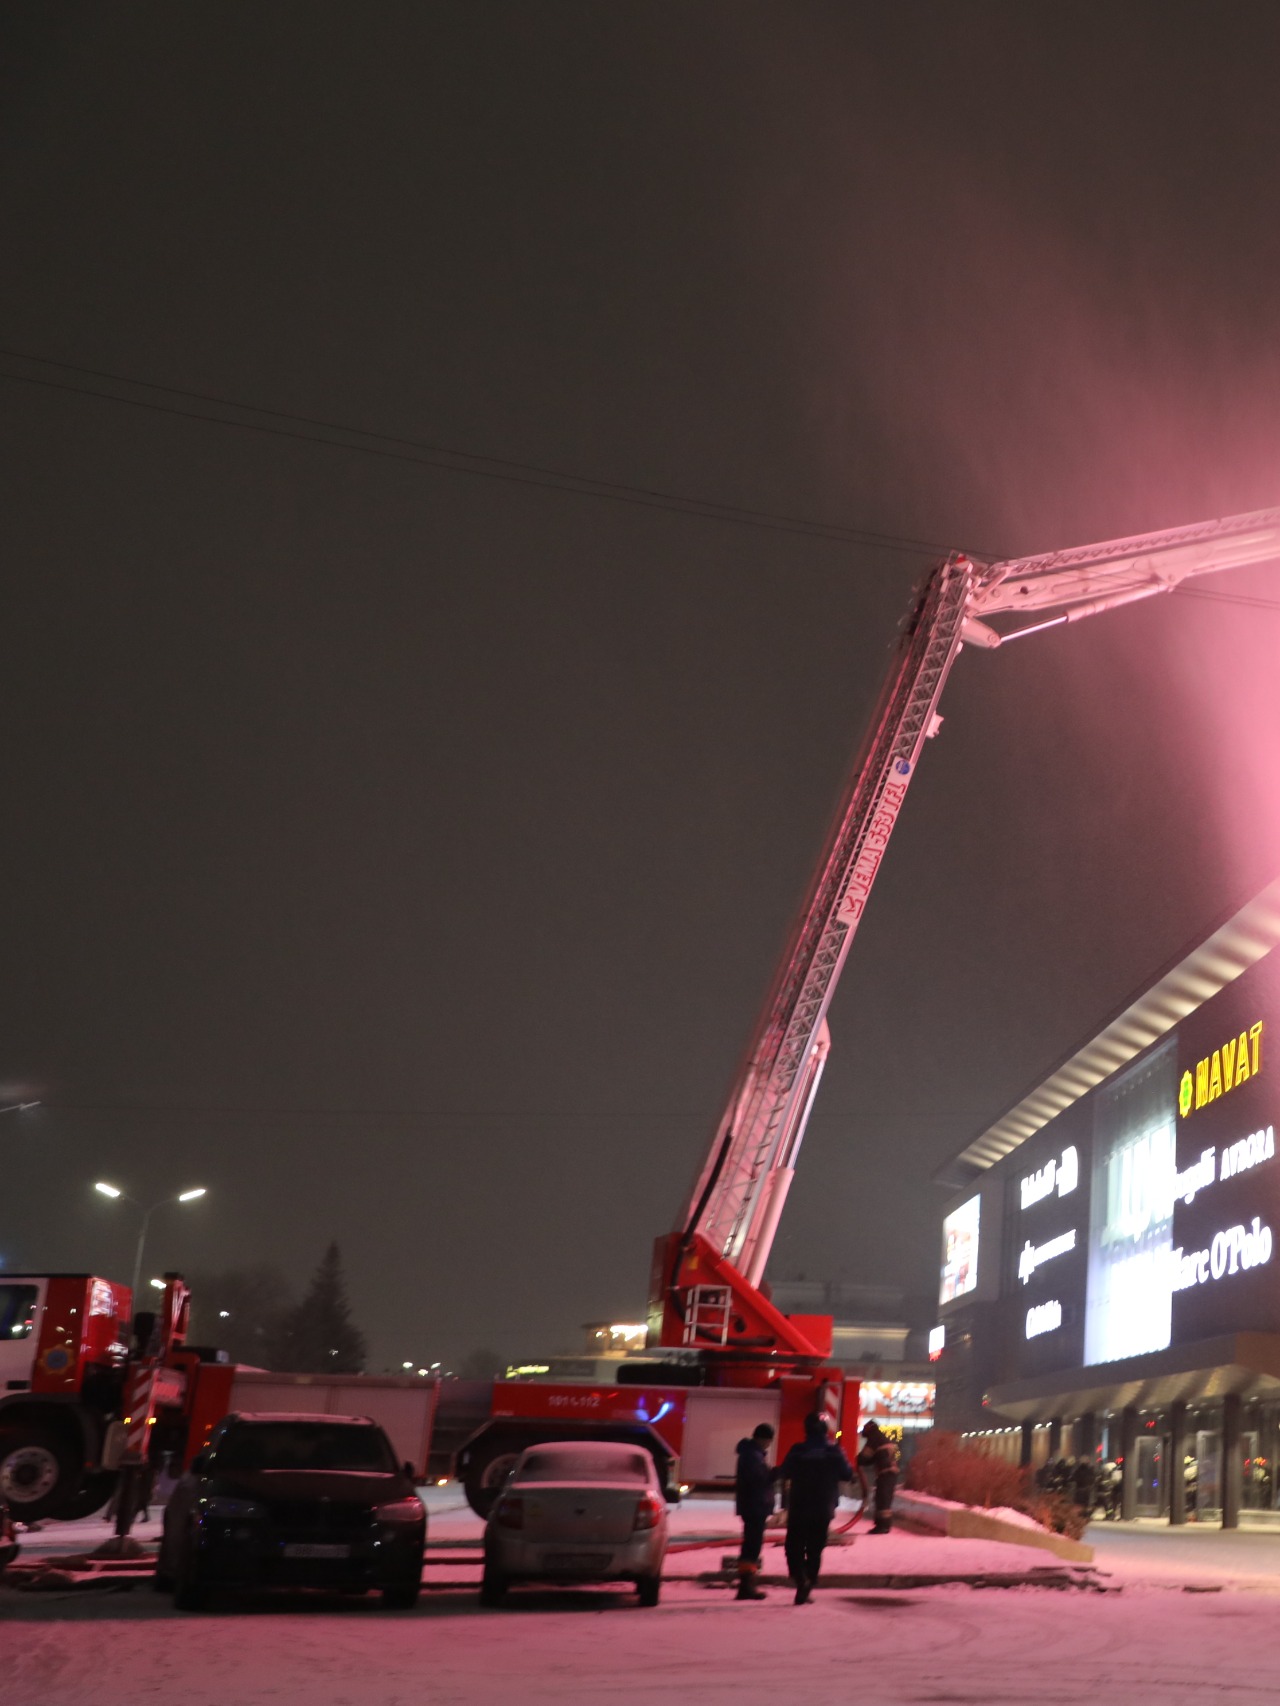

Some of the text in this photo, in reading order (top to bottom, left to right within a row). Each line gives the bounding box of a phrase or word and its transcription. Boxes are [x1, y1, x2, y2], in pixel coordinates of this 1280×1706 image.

[850, 846, 882, 896] VEMA
[884, 782, 906, 811] TFL
[1195, 1020, 1263, 1110] NAVAT
